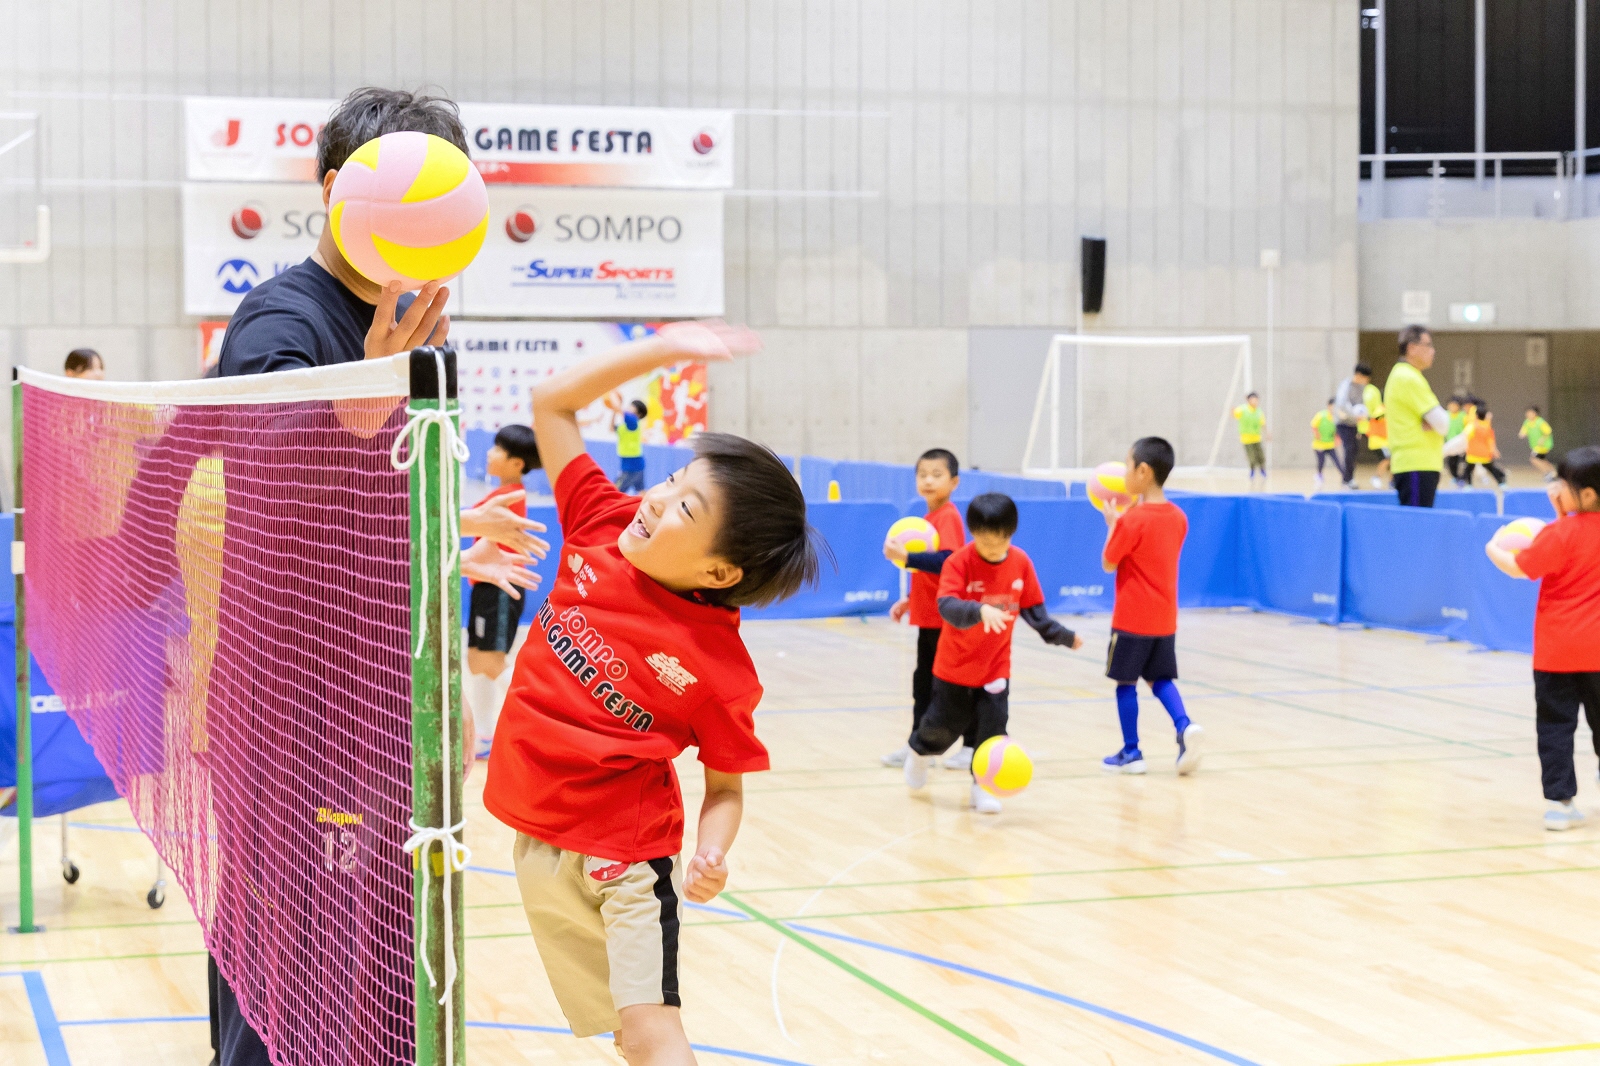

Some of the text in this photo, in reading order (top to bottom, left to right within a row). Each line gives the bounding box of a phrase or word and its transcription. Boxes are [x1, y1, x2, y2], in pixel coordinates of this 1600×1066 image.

[275, 122, 652, 154] SO GAME FESTA
[555, 213, 683, 244] SOMPO
[527, 259, 595, 281] SUPER
[596, 260, 676, 282] SPORTS
[559, 605, 629, 682] SOMPO
[547, 624, 599, 687] GAME
[591, 680, 655, 734] FESTA
